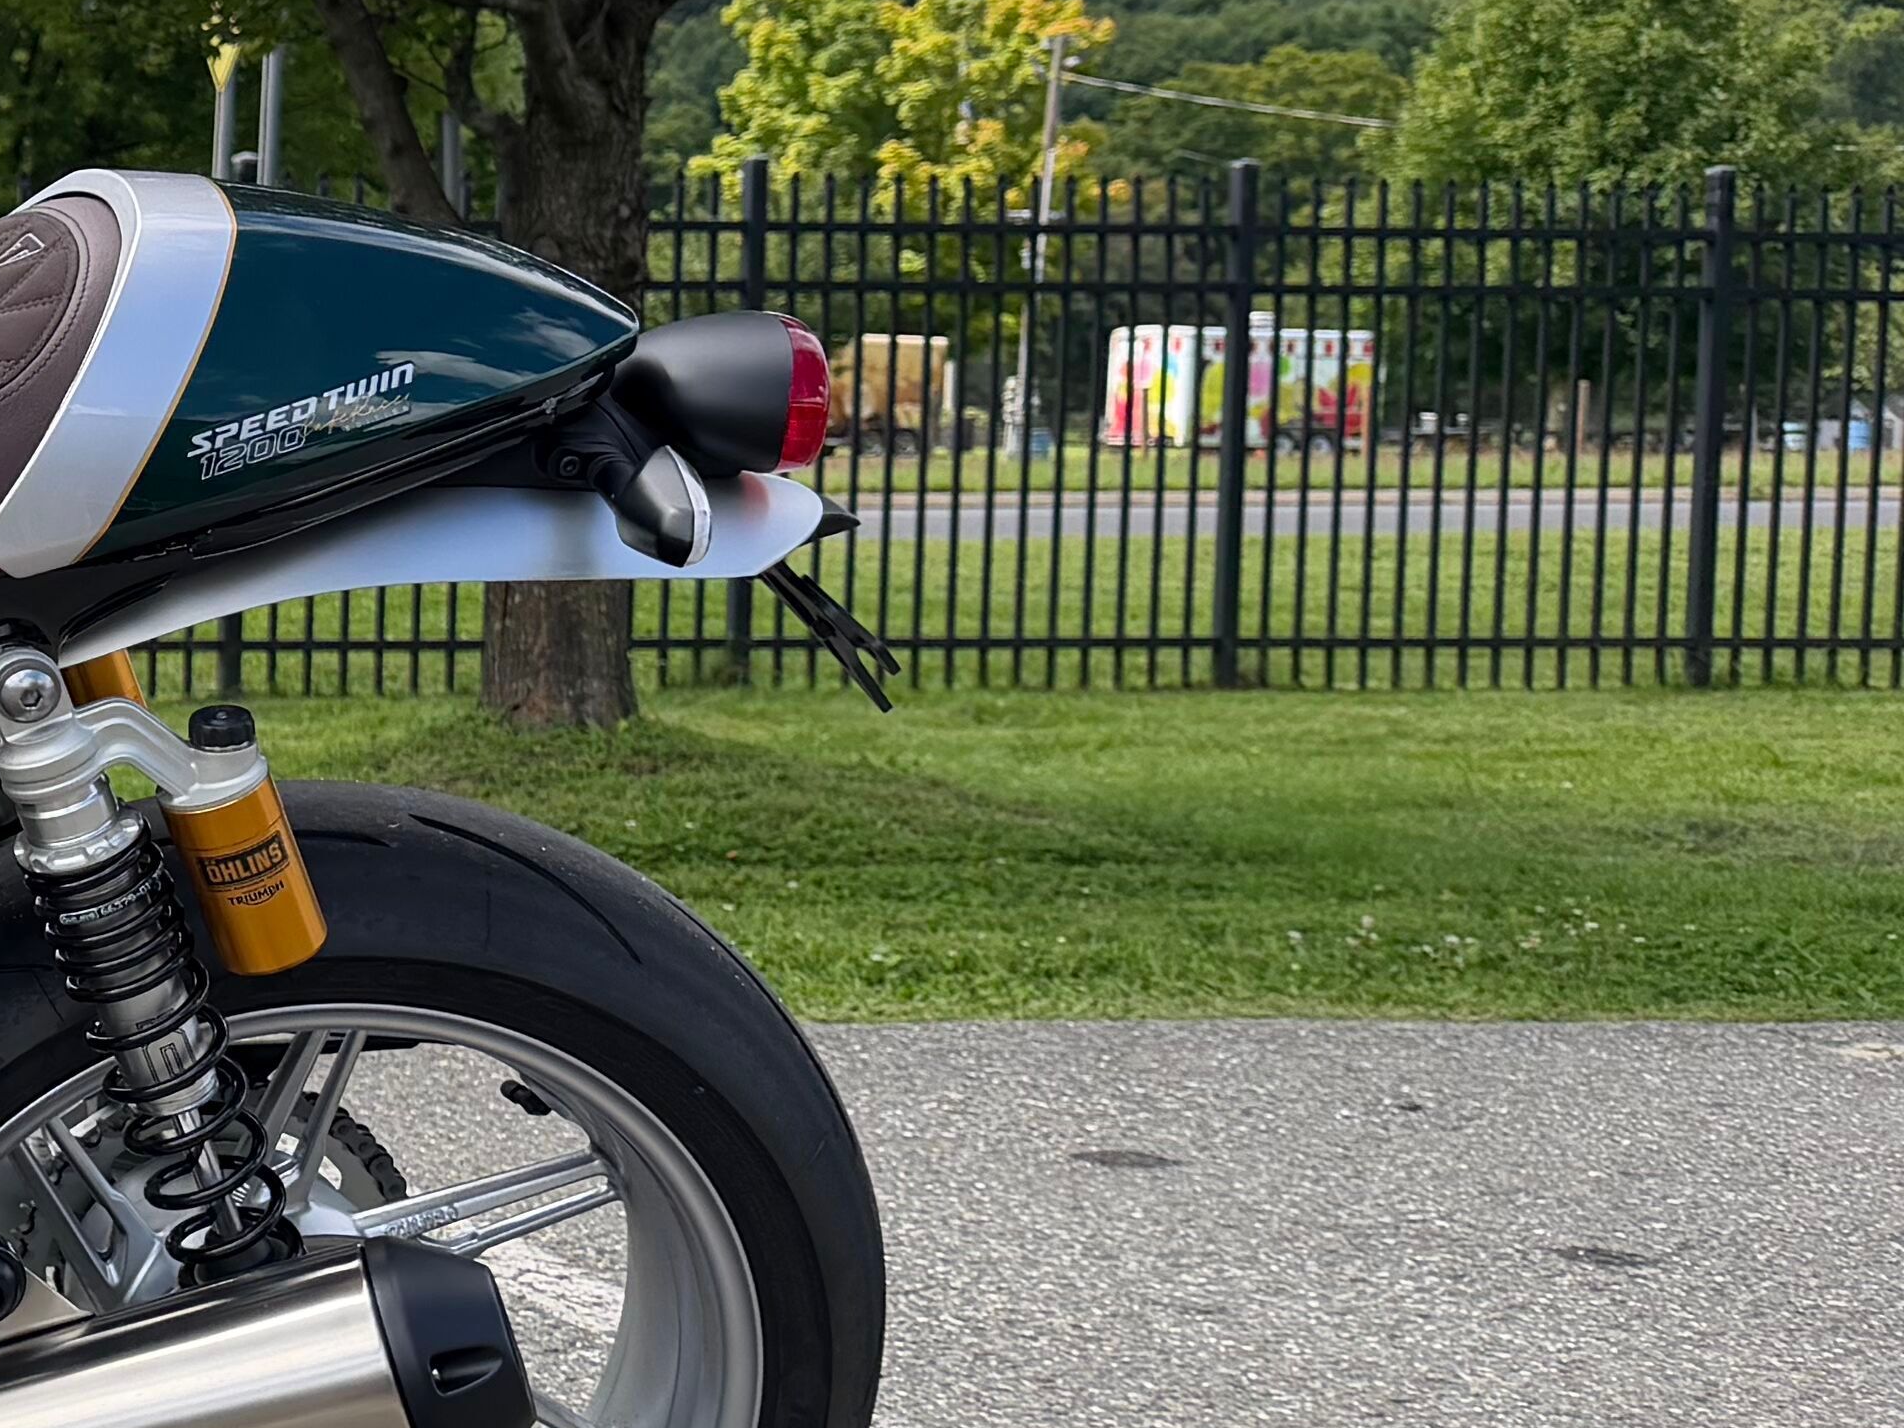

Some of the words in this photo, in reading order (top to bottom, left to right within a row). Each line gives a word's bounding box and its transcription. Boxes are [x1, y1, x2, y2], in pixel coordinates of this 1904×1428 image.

[187, 396, 318, 458] SPEED
[200, 423, 307, 481] 1200
[204, 841, 283, 884] ÖHLINS
[227, 880, 285, 906] TRIUMPH
